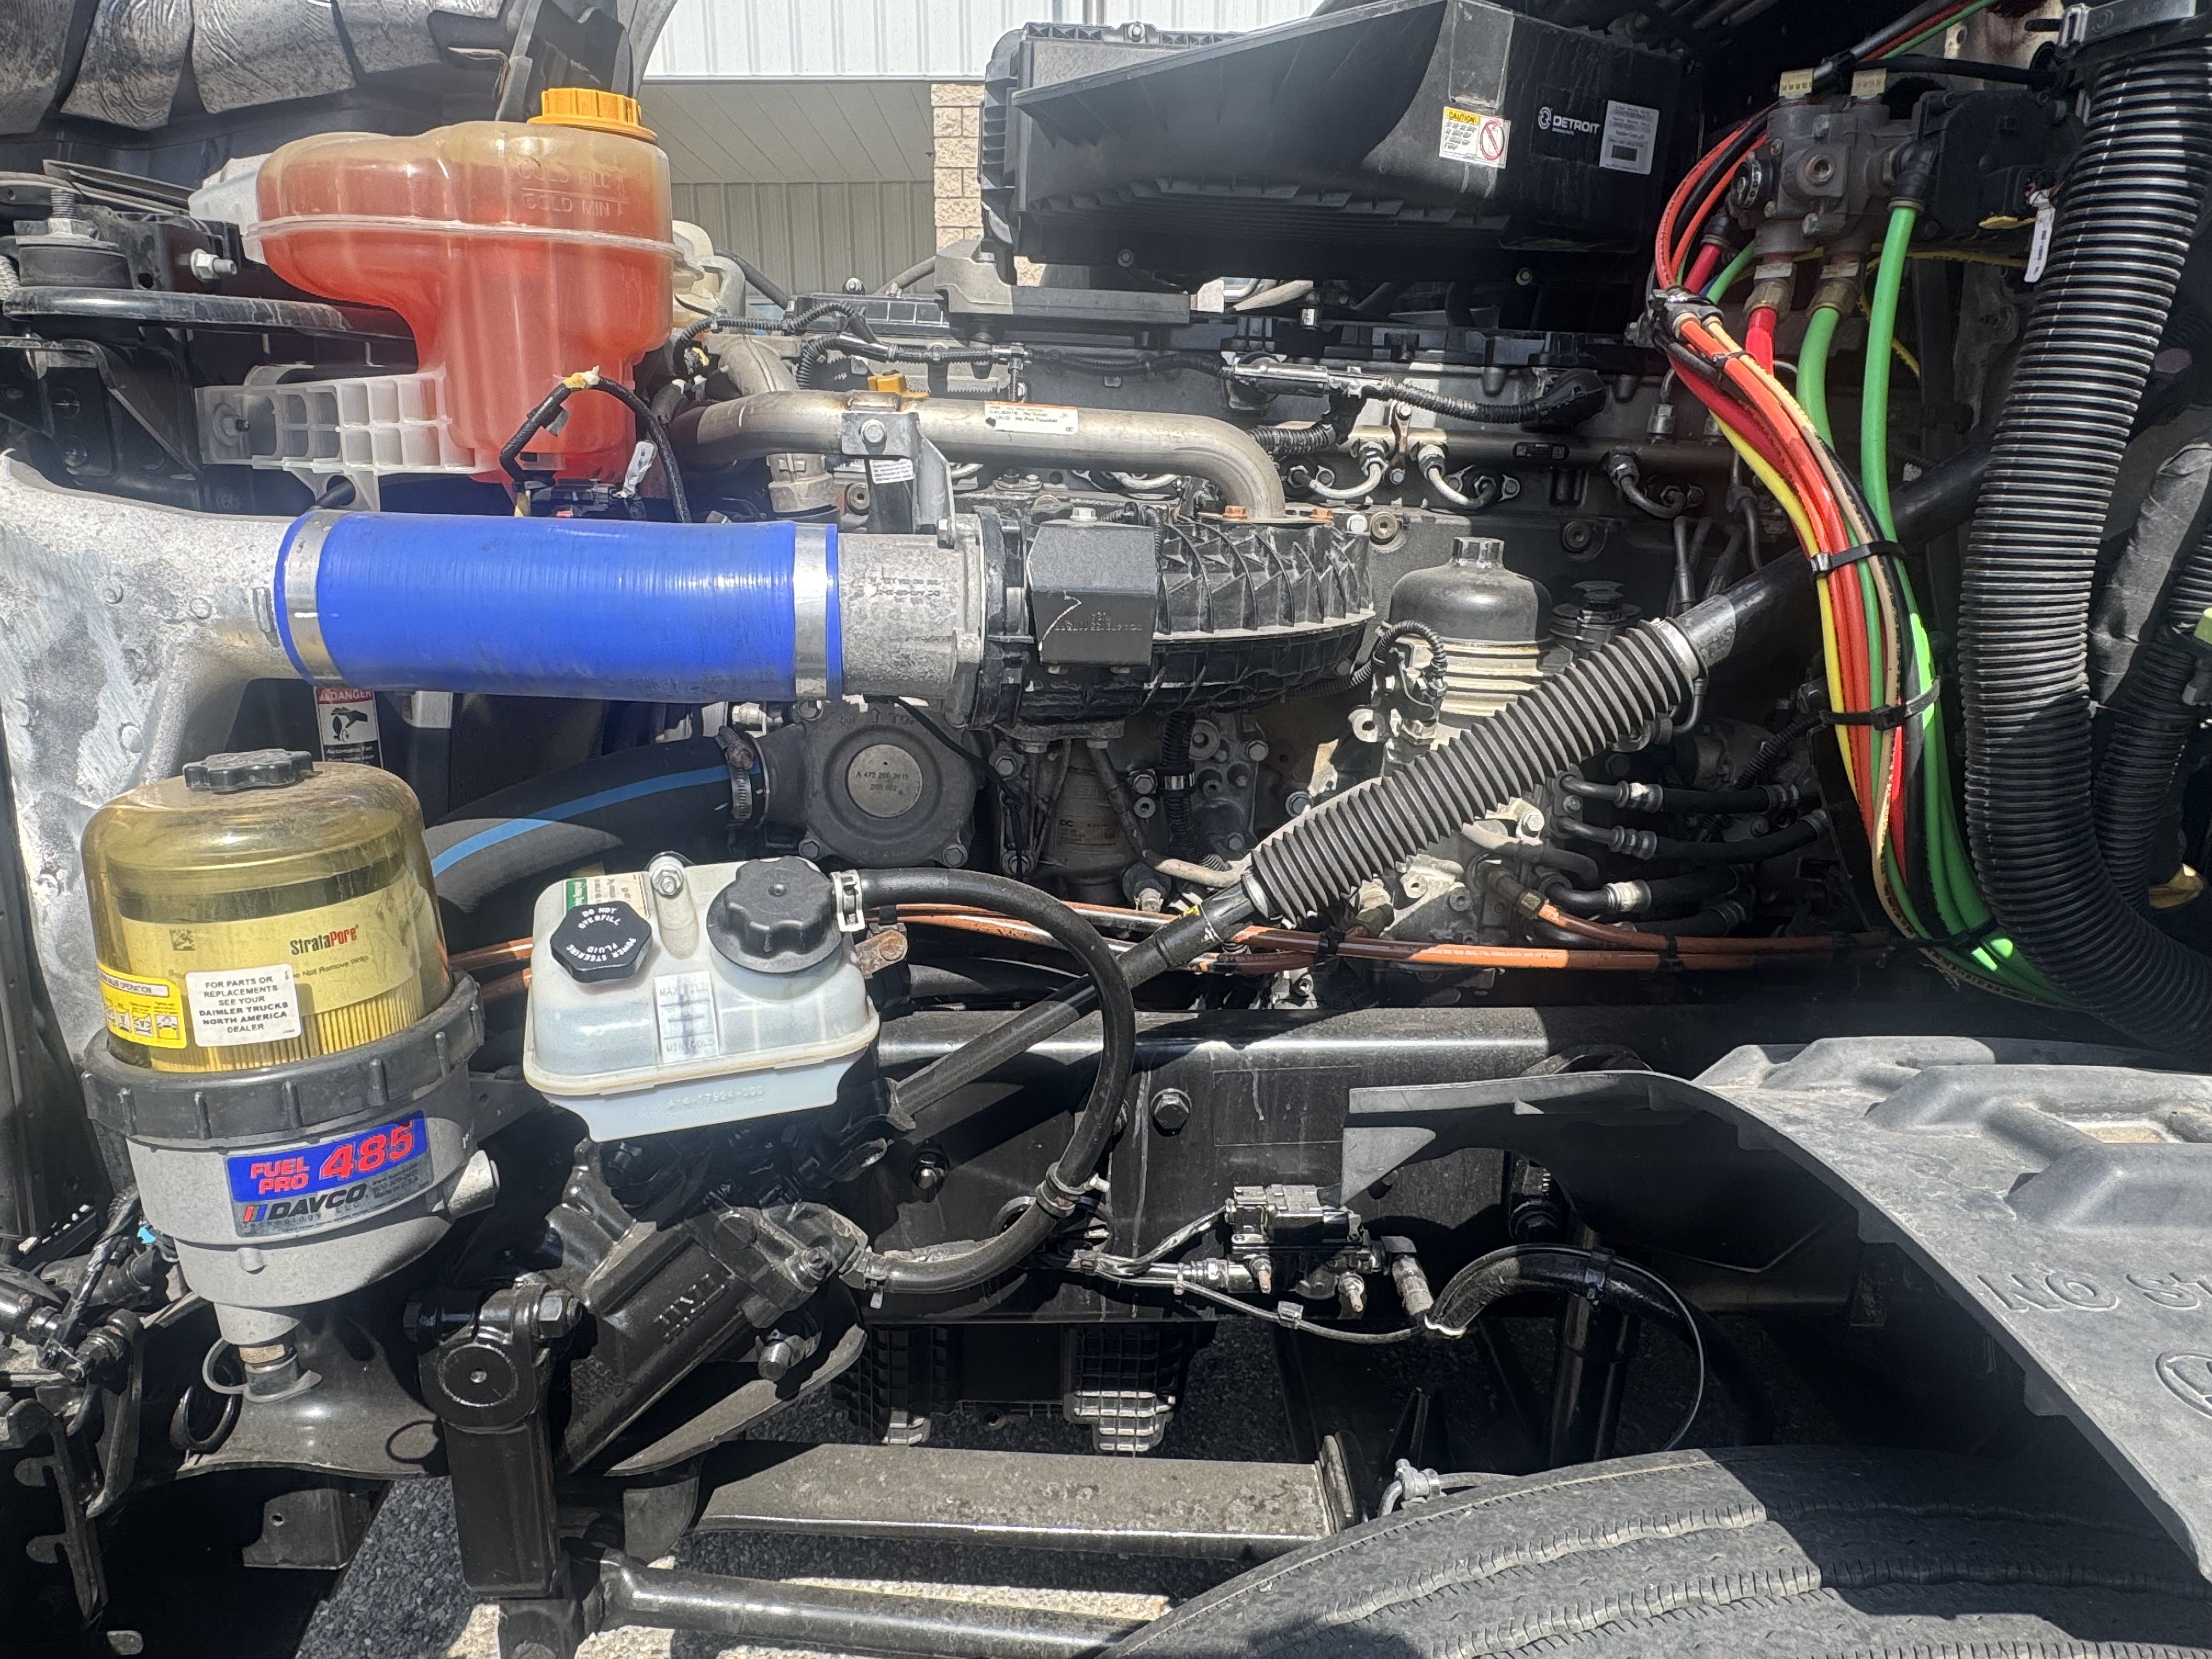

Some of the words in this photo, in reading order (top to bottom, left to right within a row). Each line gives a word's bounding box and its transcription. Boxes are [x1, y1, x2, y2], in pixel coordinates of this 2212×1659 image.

[1553, 115, 1600, 134] DETROIT
[523, 193, 573, 212] COLD
[582, 199, 610, 217] MIN
[582, 909, 595, 917] DO
[578, 914, 621, 929] OVERFILL
[319, 961, 349, 974] Remove
[226, 978, 257, 987] PARTS
[258, 975, 274, 984] OR
[204, 984, 279, 997] REPLACEMENTS
[218, 998, 236, 1006] SEE
[239, 995, 265, 1005] YOUR
[199, 1007, 244, 1016] DAIMLER
[245, 1002, 289, 1013] TRUCKS
[202, 1017, 237, 1025] NORTH
[240, 1011, 287, 1023] AMERICA
[227, 1023, 264, 1034] DEALER
[319, 1121, 414, 1181] 485
[250, 1156, 310, 1179] FUEL
[258, 1173, 309, 1194] PRO
[268, 1183, 368, 1220] DAVCO
[1977, 1272, 2121, 1313] NO
